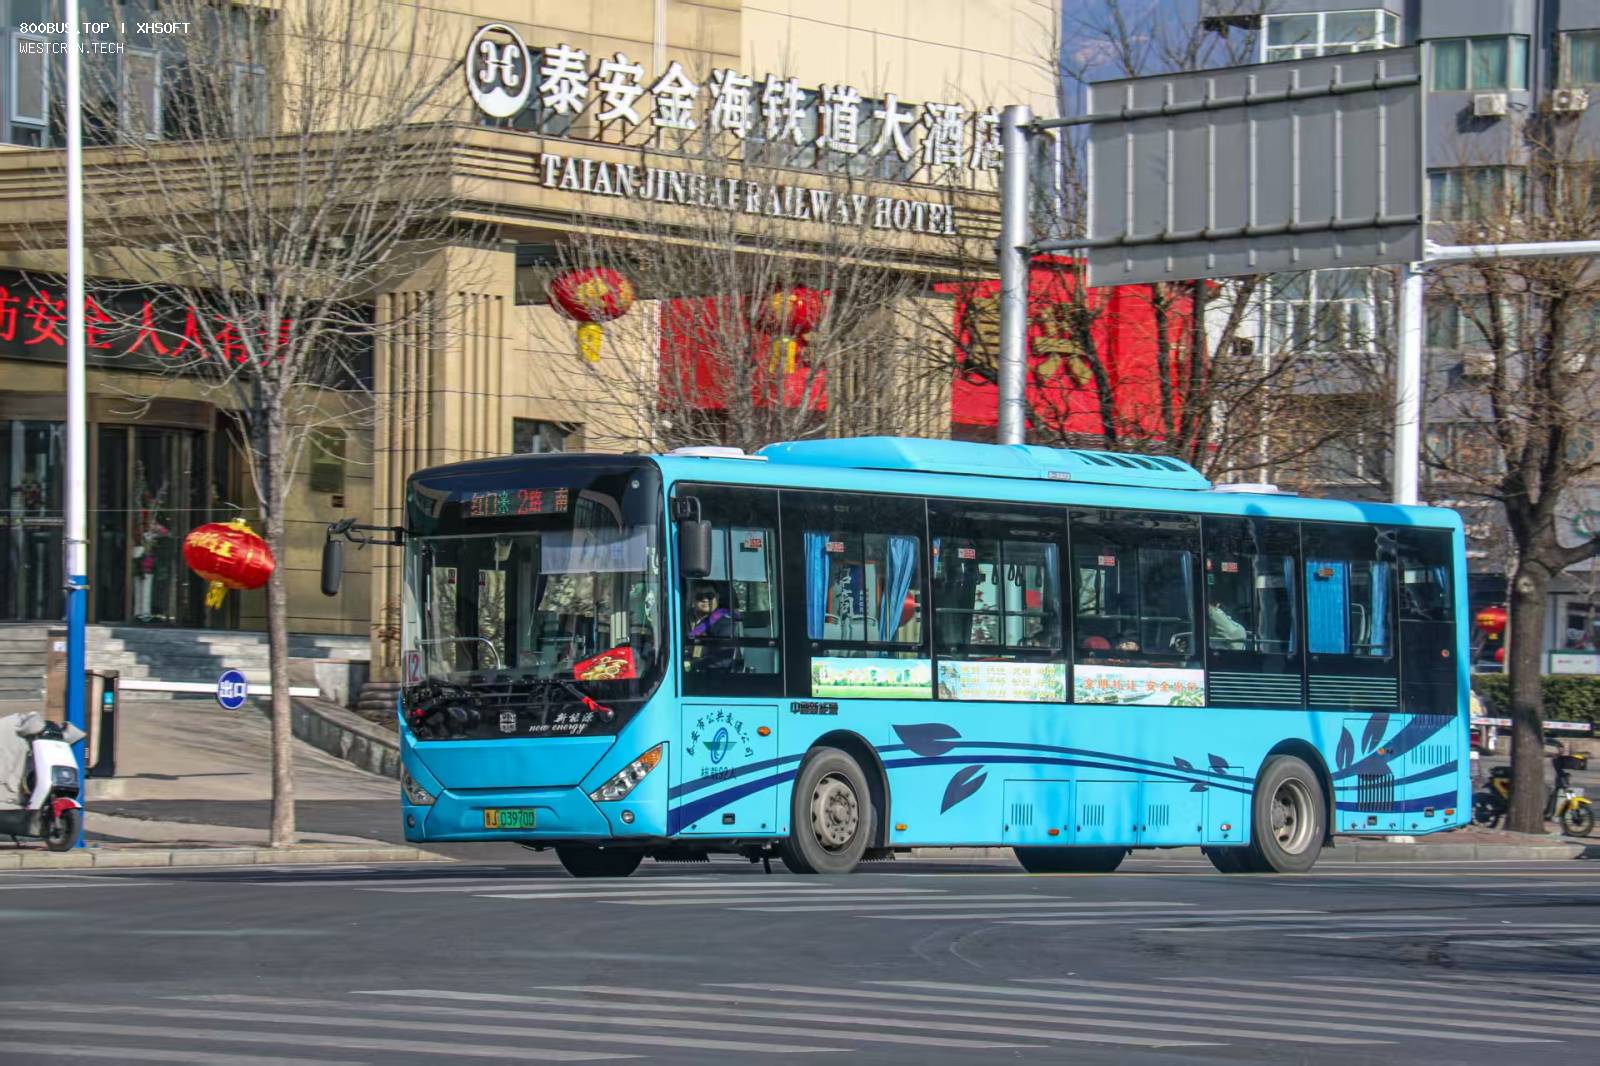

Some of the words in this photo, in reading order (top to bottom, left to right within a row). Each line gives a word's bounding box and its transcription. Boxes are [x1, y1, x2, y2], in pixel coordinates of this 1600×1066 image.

[538, 43, 1003, 171] 泰安金海铁道大酒店
[540, 153, 634, 198] TAIAN
[746, 180, 867, 227] RAILWAY
[874, 196, 957, 236] HOTEL
[220, 680, 246, 698] 出口
[551, 722, 587, 735] energy
